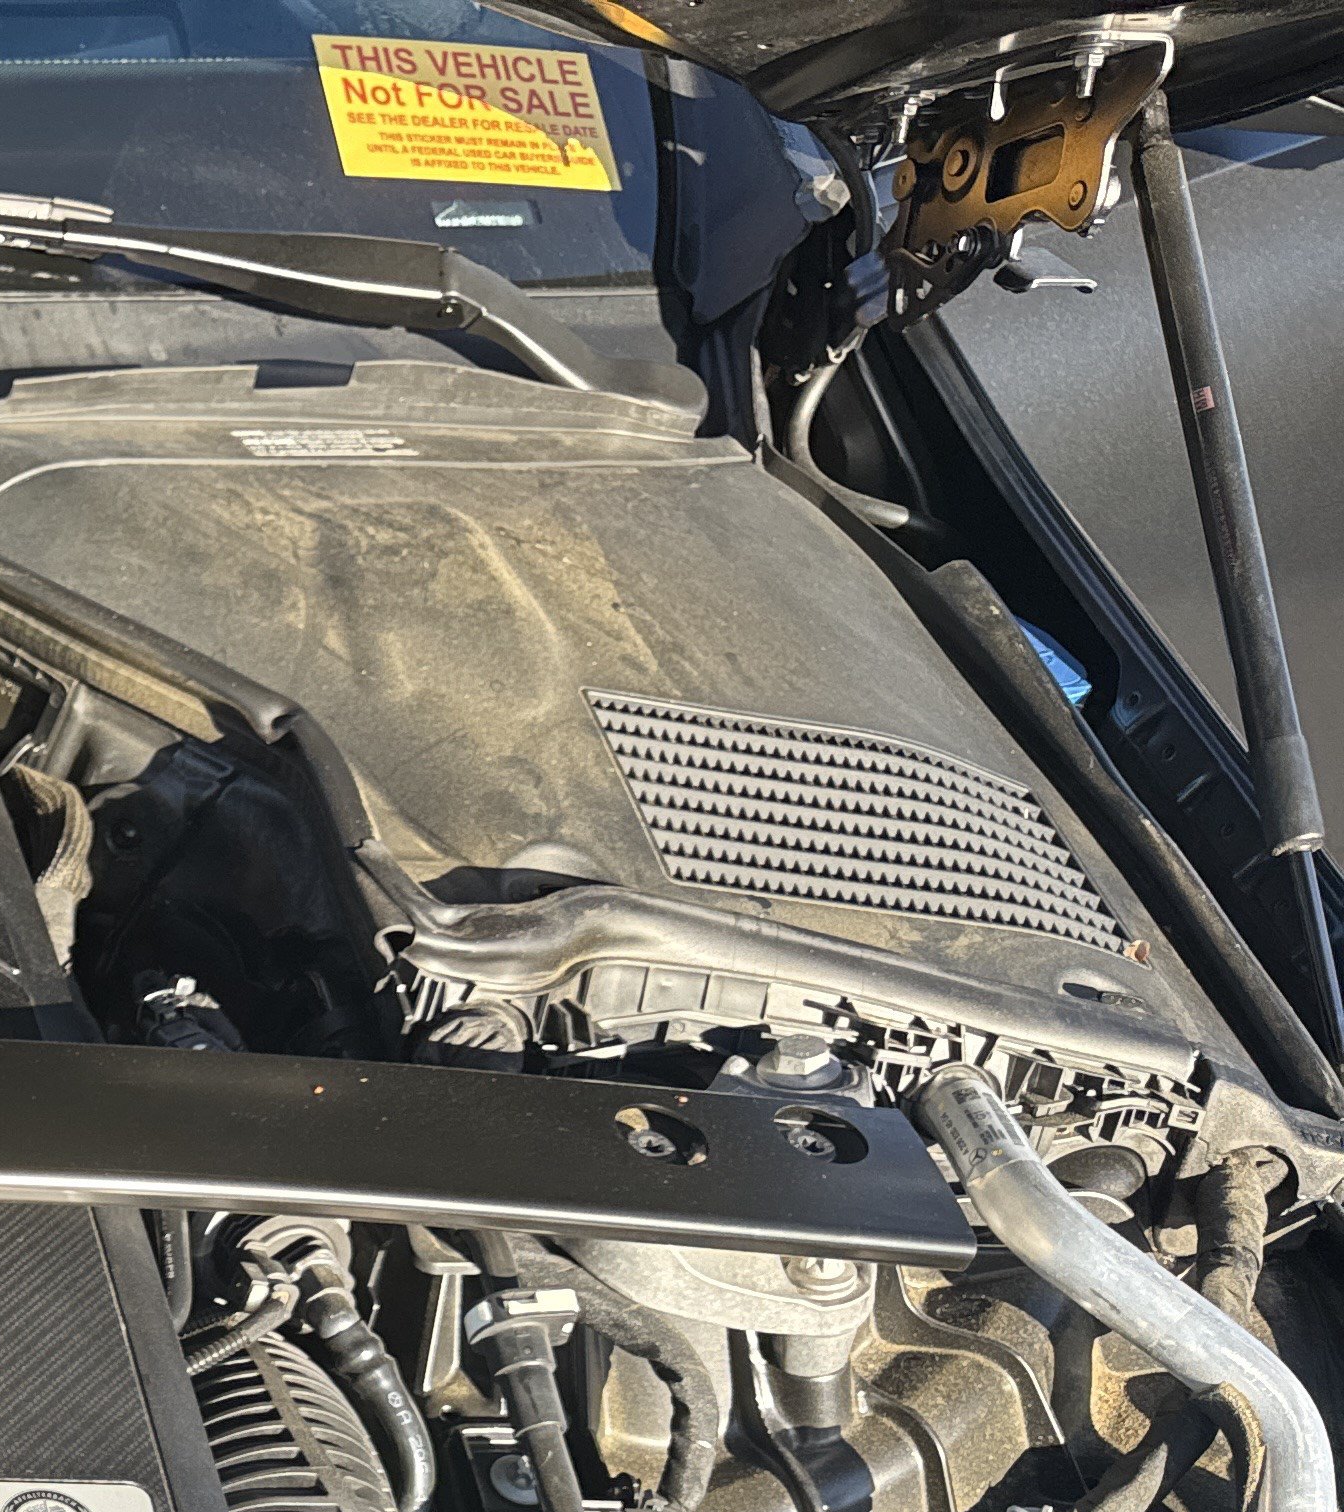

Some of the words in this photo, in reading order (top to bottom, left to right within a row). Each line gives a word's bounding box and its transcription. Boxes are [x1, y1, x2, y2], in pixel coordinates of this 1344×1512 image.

[331, 44, 418, 75] THIS
[425, 49, 583, 86] VEHICLE
[342, 77, 406, 106] Not
[415, 82, 492, 112] FOR
[499, 86, 595, 119] SALE
[347, 112, 376, 124] SEE
[379, 113, 408, 126] THE
[411, 115, 469, 129] DEALER
[472, 118, 500, 131] FOR
[562, 124, 599, 139] DATE
[379, 132, 403, 142] THIS
[406, 134, 451, 144] STICKER
[411, 146, 461, 157] FEDERAL
